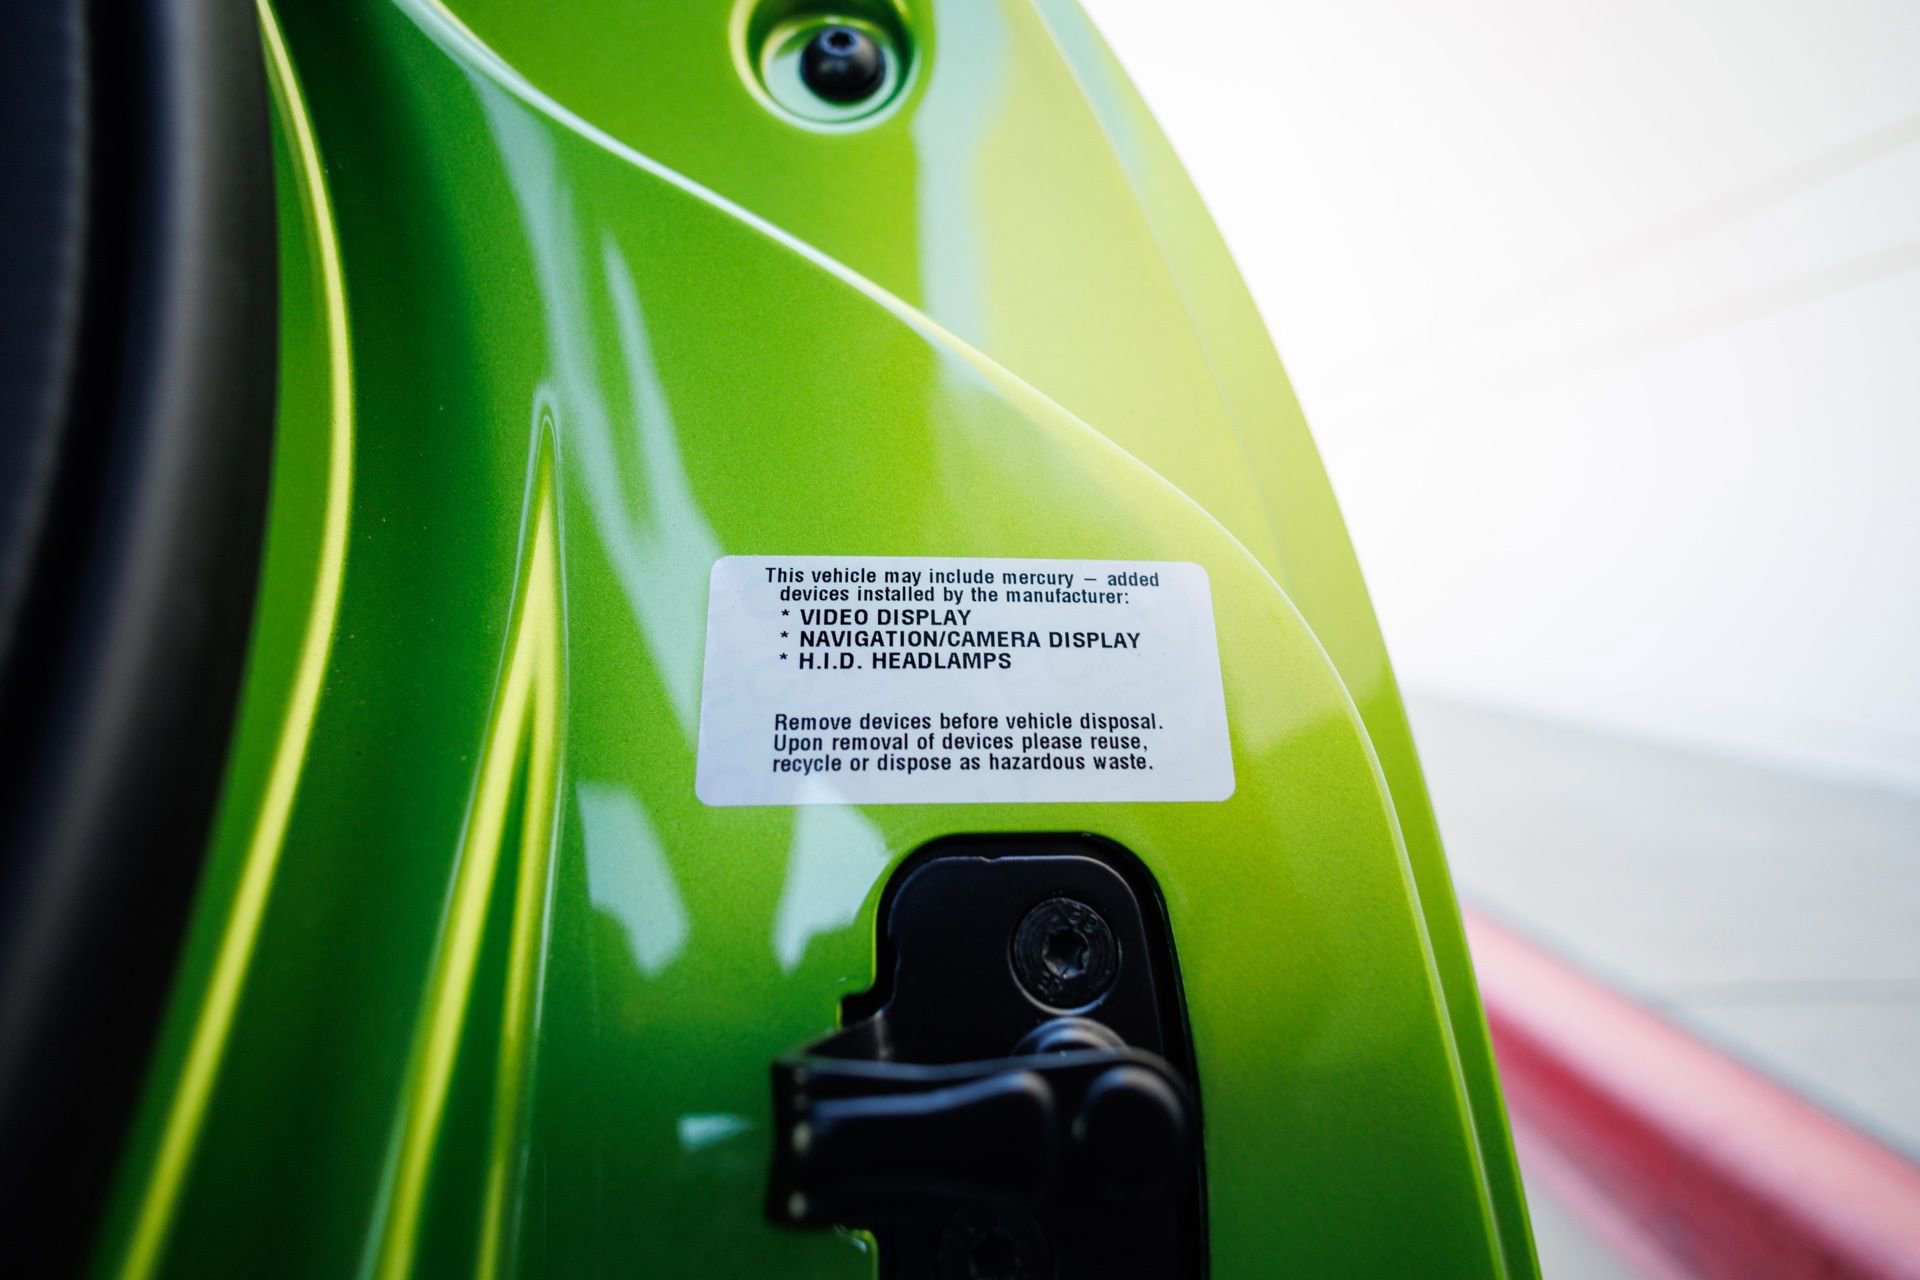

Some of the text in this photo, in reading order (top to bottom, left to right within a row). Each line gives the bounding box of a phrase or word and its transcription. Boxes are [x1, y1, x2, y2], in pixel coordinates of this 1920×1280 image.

[764, 567, 805, 584] This
[811, 567, 877, 584] vehicle
[884, 571, 922, 587] may
[929, 568, 995, 585] include
[1002, 572, 1074, 589] mercury
[1107, 571, 1160, 588] added
[779, 585, 1129, 606] devices installed by the manufacturer:
[799, 608, 869, 626] VIDEO
[877, 608, 972, 626] DISPLAY
[799, 630, 1042, 648] NAVIGATION/CAMERA
[1048, 631, 1141, 650] DISPLAY
[798, 651, 863, 670] H.I.D.
[872, 651, 1012, 670] HEADLAMPS
[774, 712, 1164, 734] Remove devices before vehicle disposal.
[773, 732, 1148, 756] Upon removal of devices please reuse,
[772, 752, 1154, 777] recycle or dispose as hazardous waste.
